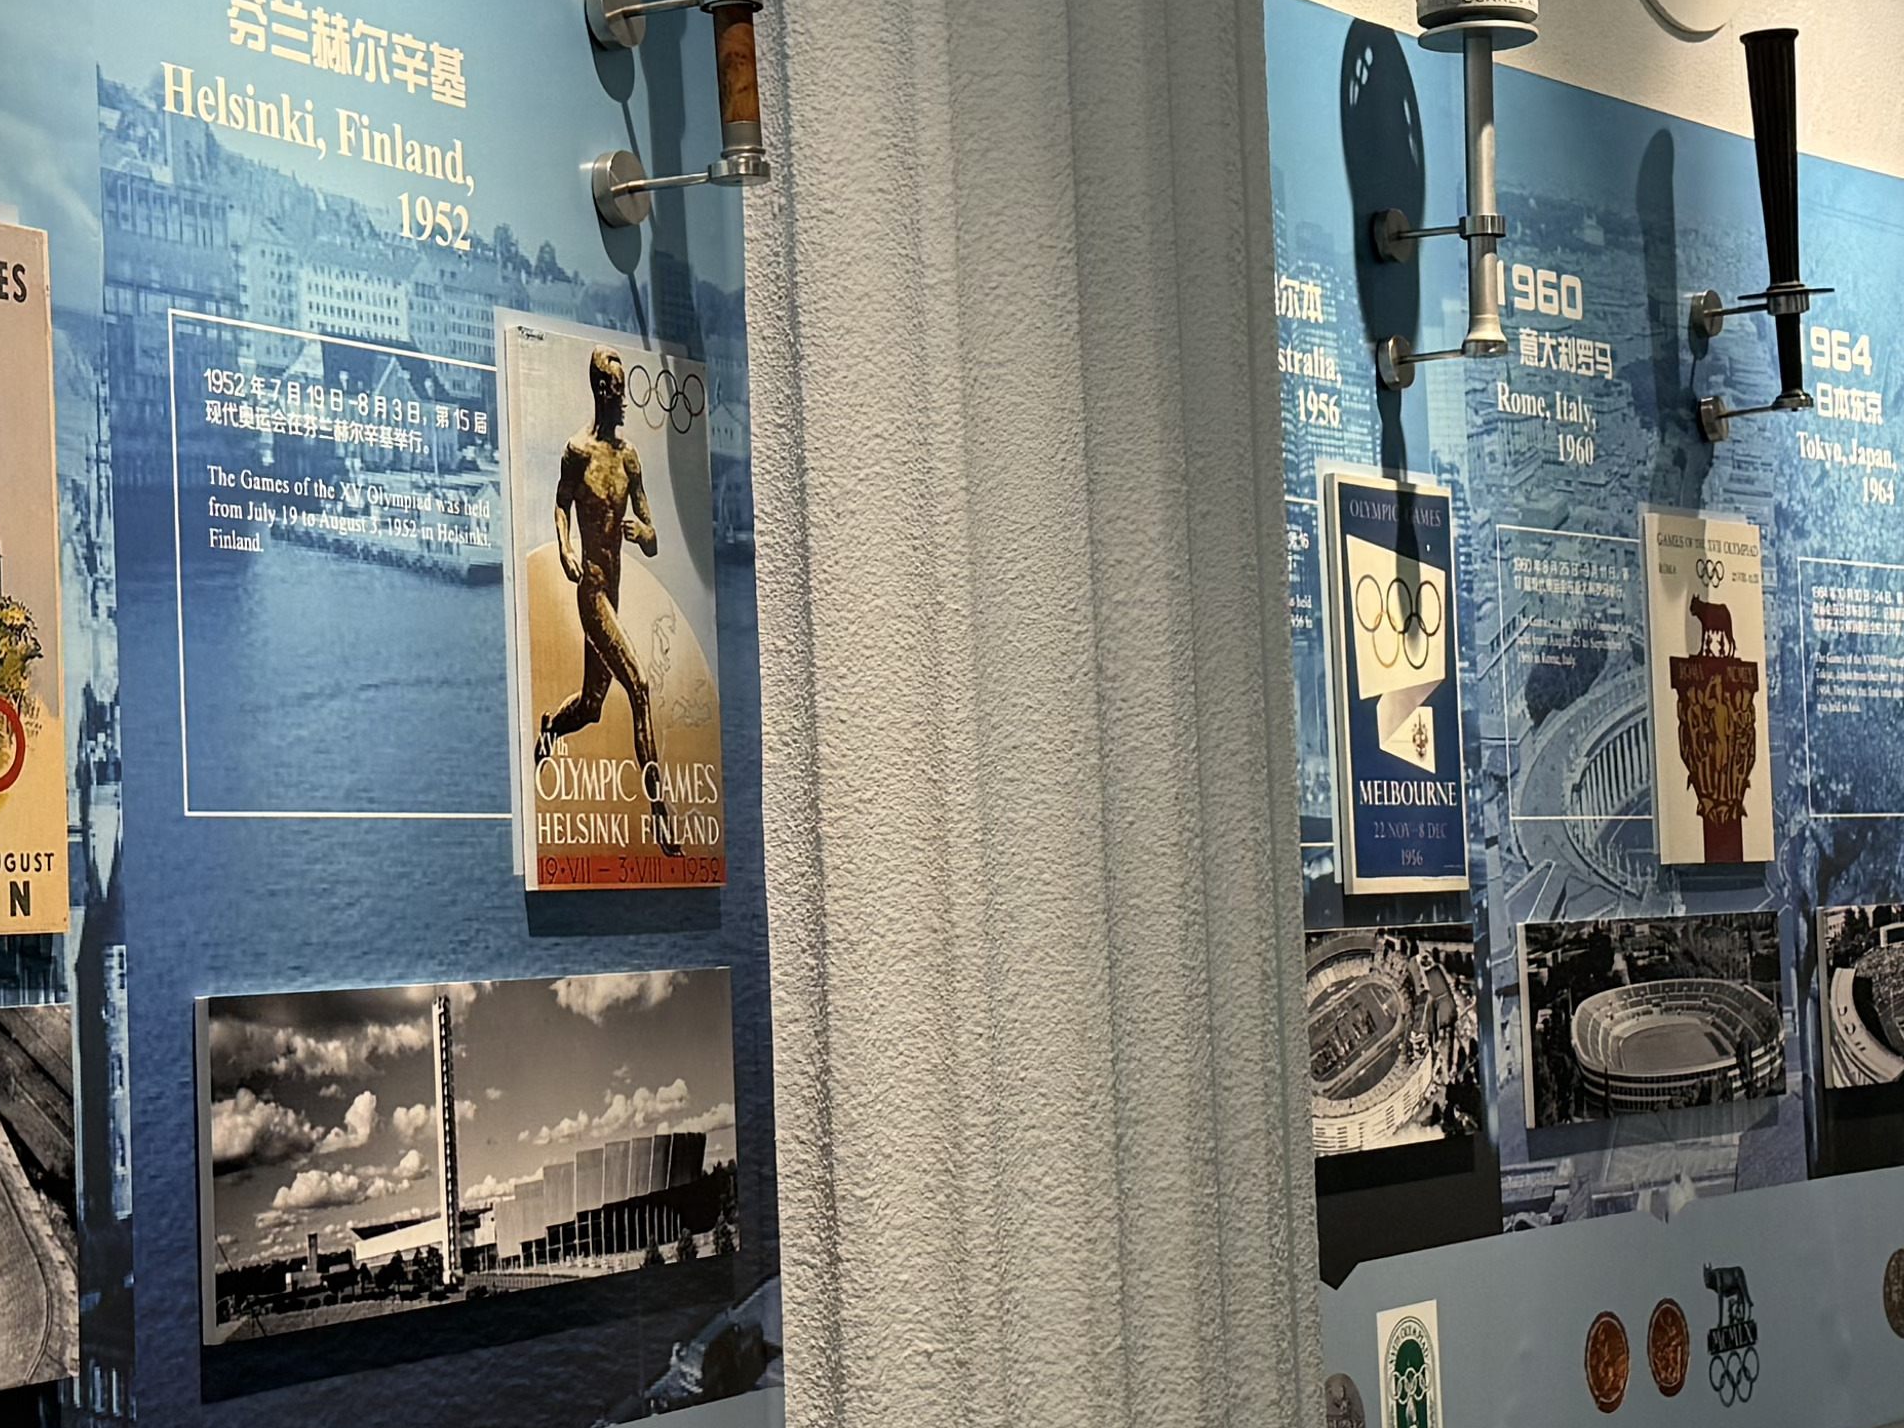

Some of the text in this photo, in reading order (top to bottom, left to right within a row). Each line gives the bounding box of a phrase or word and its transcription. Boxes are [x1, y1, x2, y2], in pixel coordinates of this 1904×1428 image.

[161, 61, 476, 197] Helsinki, Finland,
[397, 192, 471, 251] 1952
[1275, 273, 1324, 324] 尔本
[1497, 260, 1584, 320] 1960
[1278, 345, 1342, 388] stralia,
[1518, 327, 1613, 379] 意大利罗马
[1810, 326, 1872, 376] 964
[1297, 390, 1340, 426] 1956
[1497, 382, 1597, 432] Rome, Italy,
[1816, 383, 1883, 425] 日本东京
[1557, 434, 1594, 465] 1960
[1796, 431, 1898, 472] Tokyo, Japan,
[207, 465, 490, 519] The Games of the XV Olympiad was held
[1861, 477, 1896, 505] 1964
[208, 496, 491, 549] from July 19 to August 3, 1952 in Helsinki,
[1349, 499, 1442, 527] OLYMPIC AMES
[209, 528, 264, 553] Finland.
[538, 730, 568, 758] XVth
[535, 757, 718, 805] OLYMPIC GAMES
[1359, 780, 1457, 806] MELBOURNE
[537, 812, 720, 848] HELSINKI FINLAND
[682, 855, 720, 883] 1952
[1401, 849, 1423, 866] 1956
[1712, 1323, 1754, 1350] MCMLX
